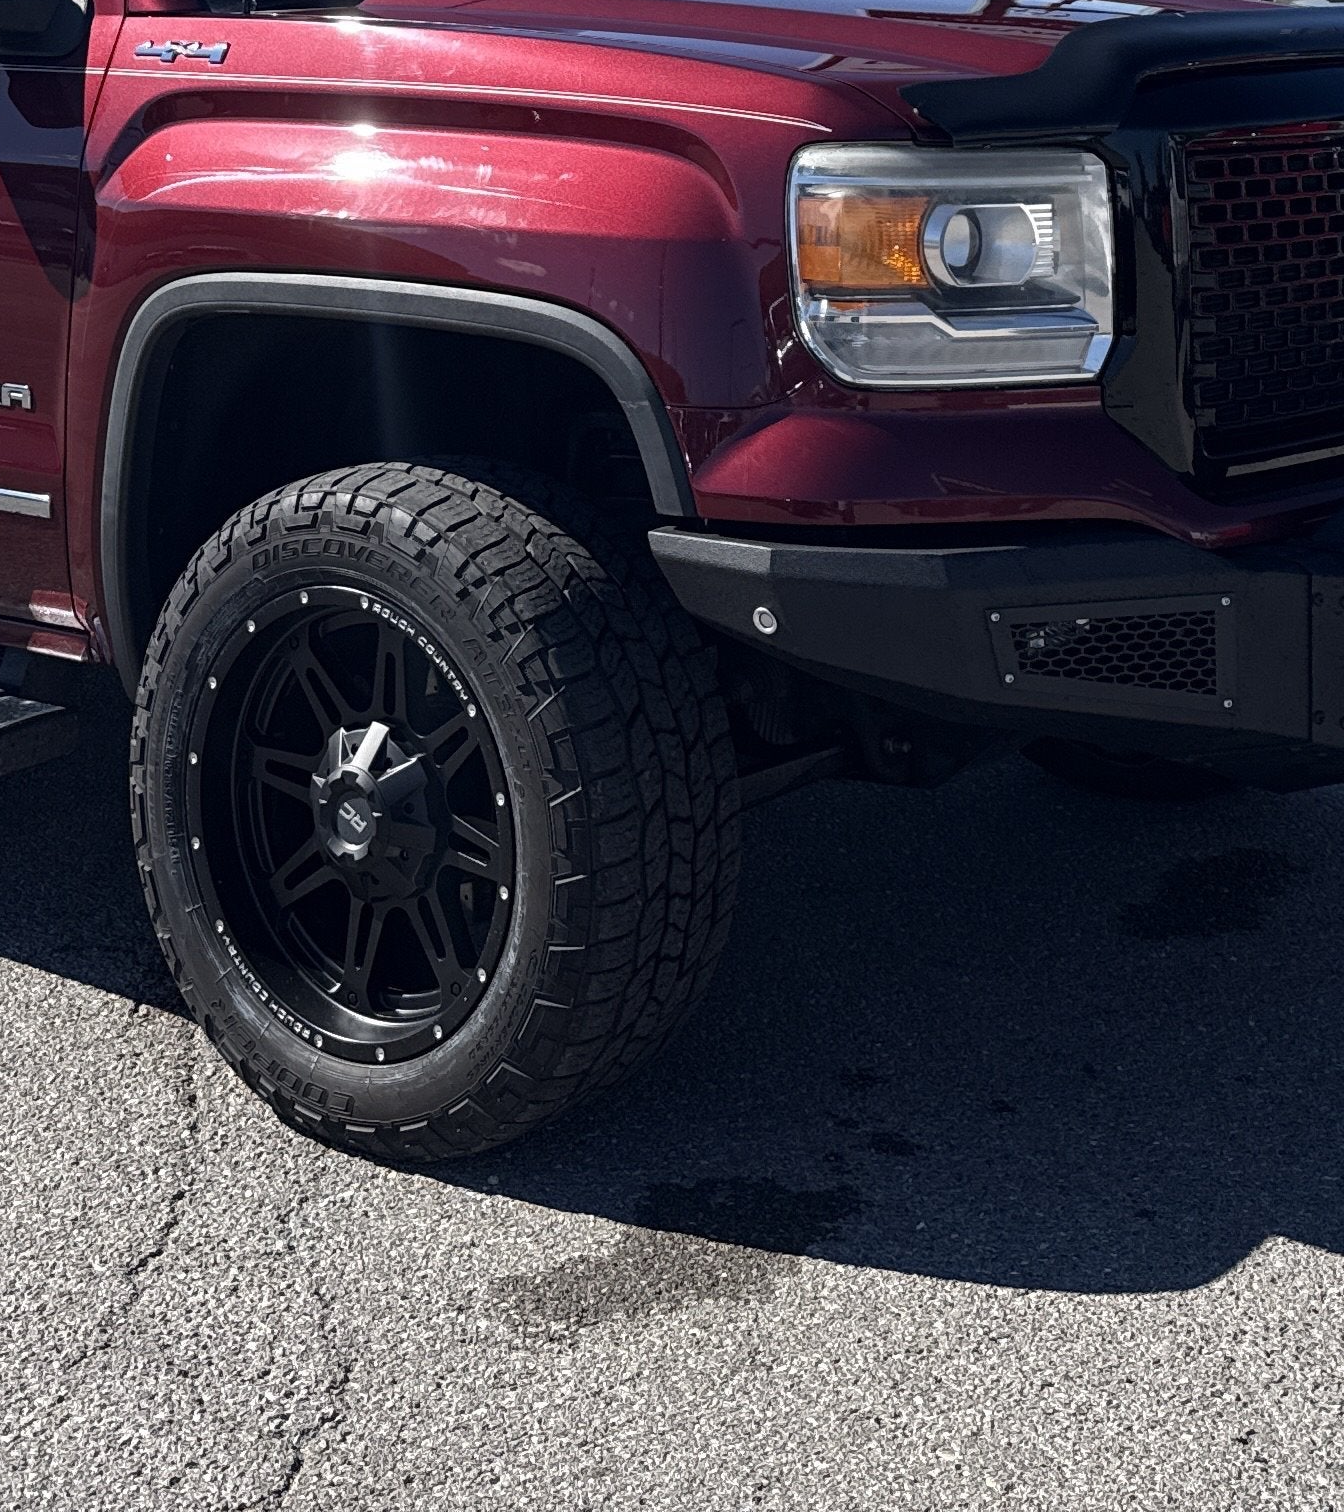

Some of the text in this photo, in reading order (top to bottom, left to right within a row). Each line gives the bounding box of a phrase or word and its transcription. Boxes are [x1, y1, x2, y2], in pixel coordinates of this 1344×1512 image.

[251, 537, 458, 624] DISCOVERER
[371, 601, 469, 701] ROUGH COUNTRY
[338, 801, 368, 835] RC
[222, 935, 311, 1040] ROUGH COUNTRY
[210, 997, 355, 1117] COOPER
